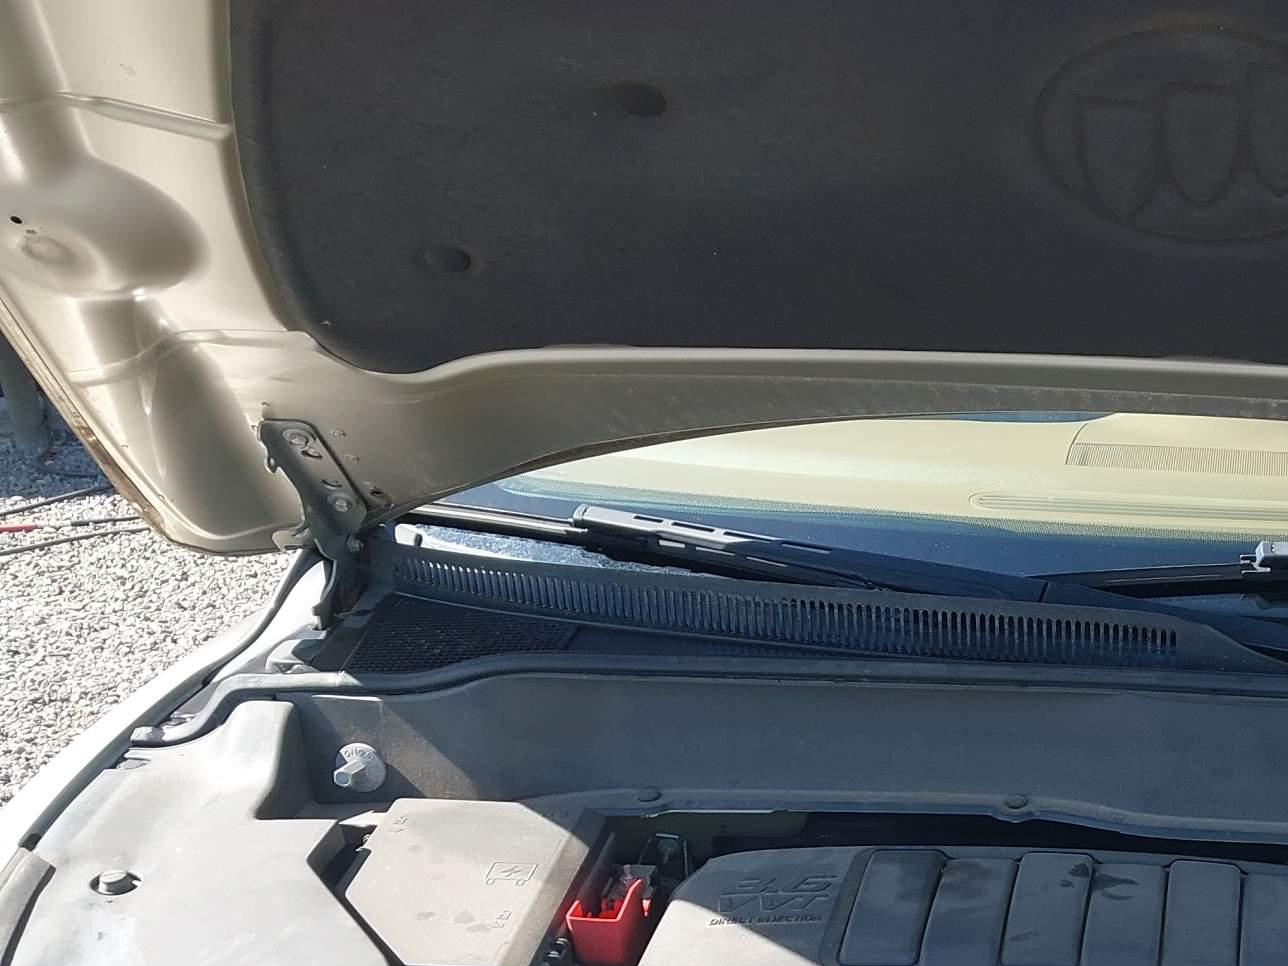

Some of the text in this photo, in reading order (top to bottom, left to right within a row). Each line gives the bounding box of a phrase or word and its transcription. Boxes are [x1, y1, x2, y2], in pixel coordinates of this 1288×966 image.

[720, 874, 838, 897] 3.6
[718, 894, 830, 914] VVT
[707, 914, 823, 927] DIRECT INJECTION
